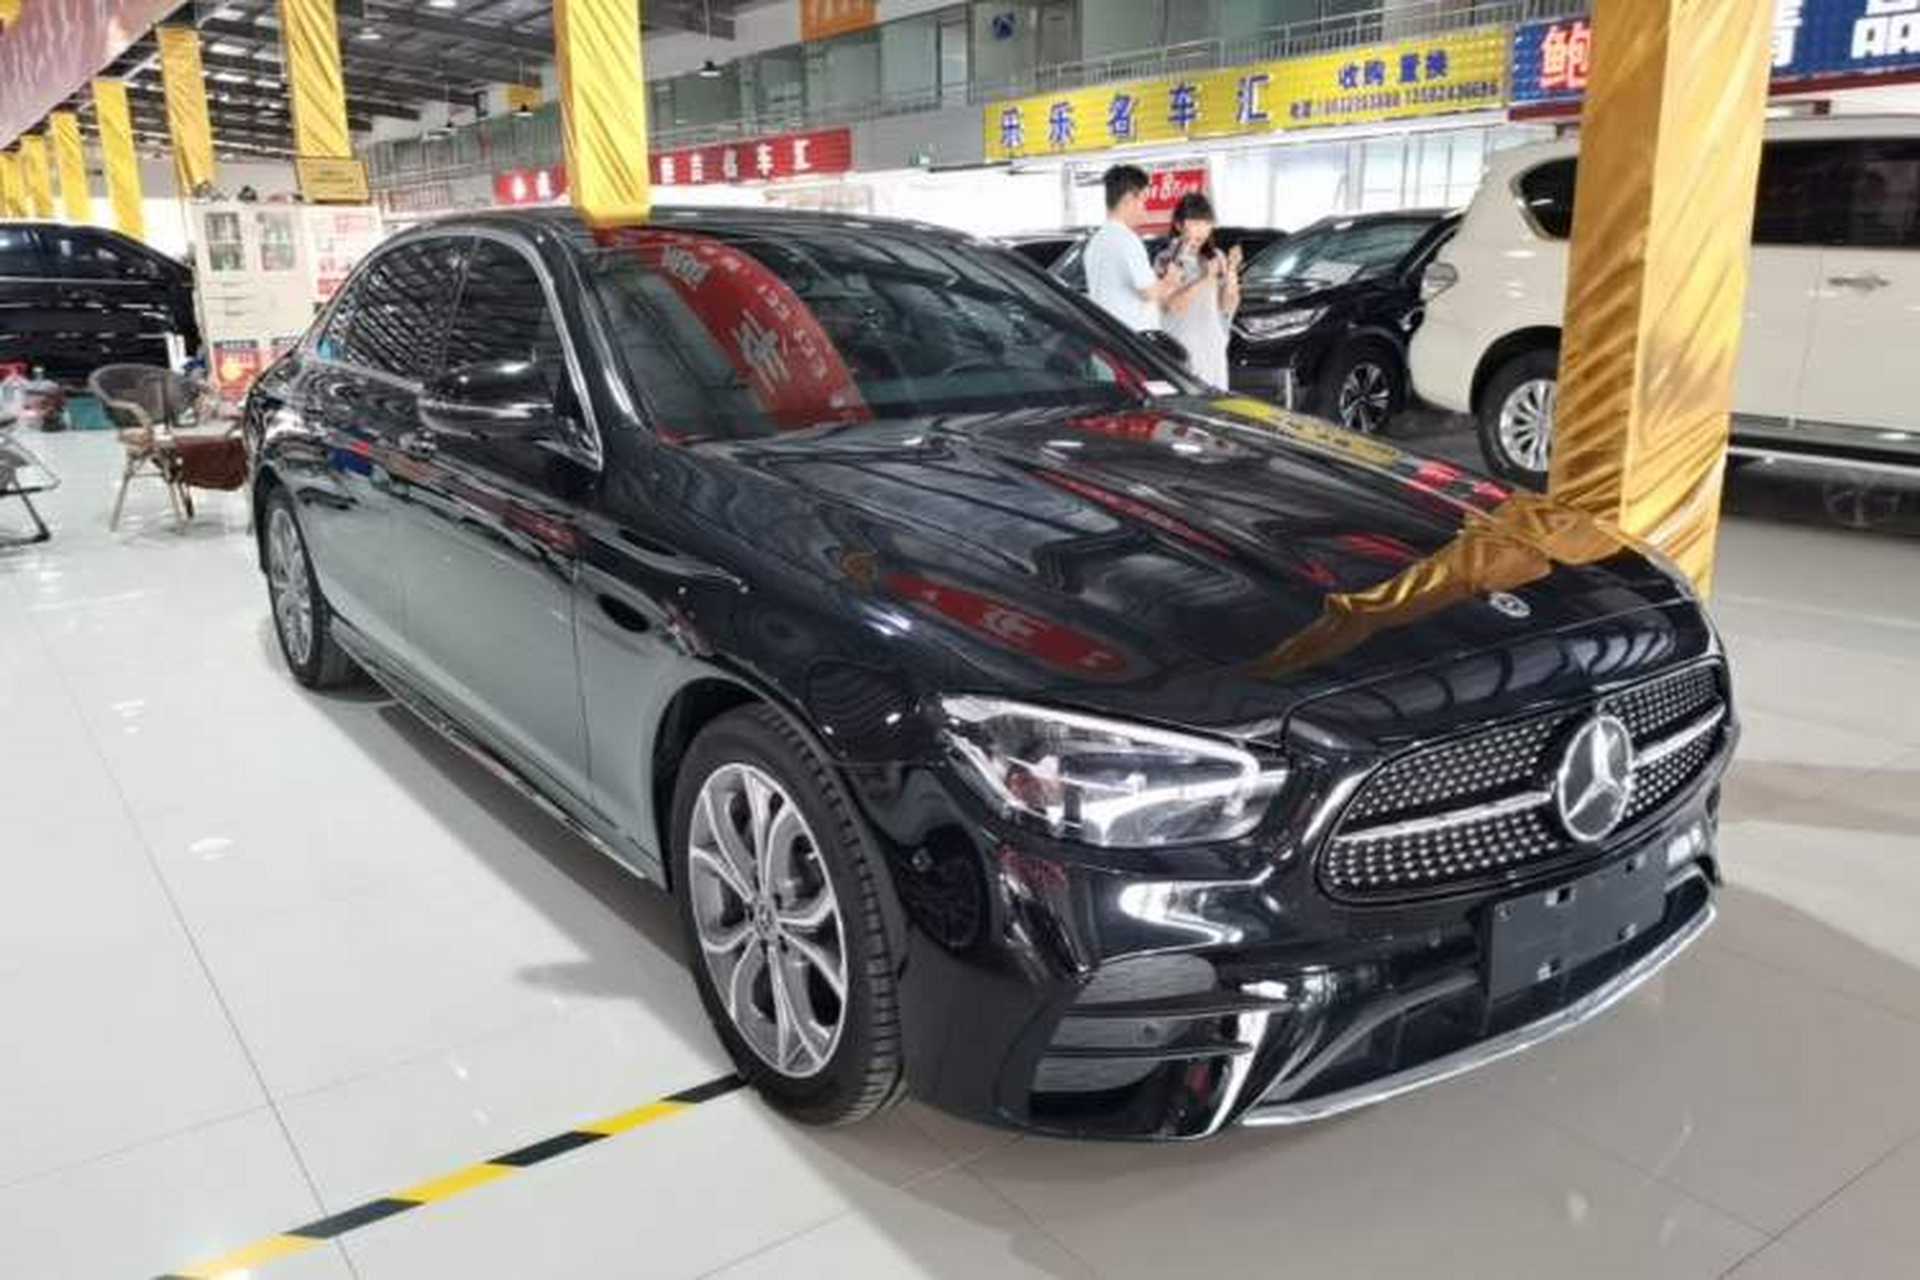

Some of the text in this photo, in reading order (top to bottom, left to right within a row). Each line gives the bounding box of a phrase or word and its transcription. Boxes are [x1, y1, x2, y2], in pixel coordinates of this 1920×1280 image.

[1001, 76, 1269, 148] 乐乐名车汇
